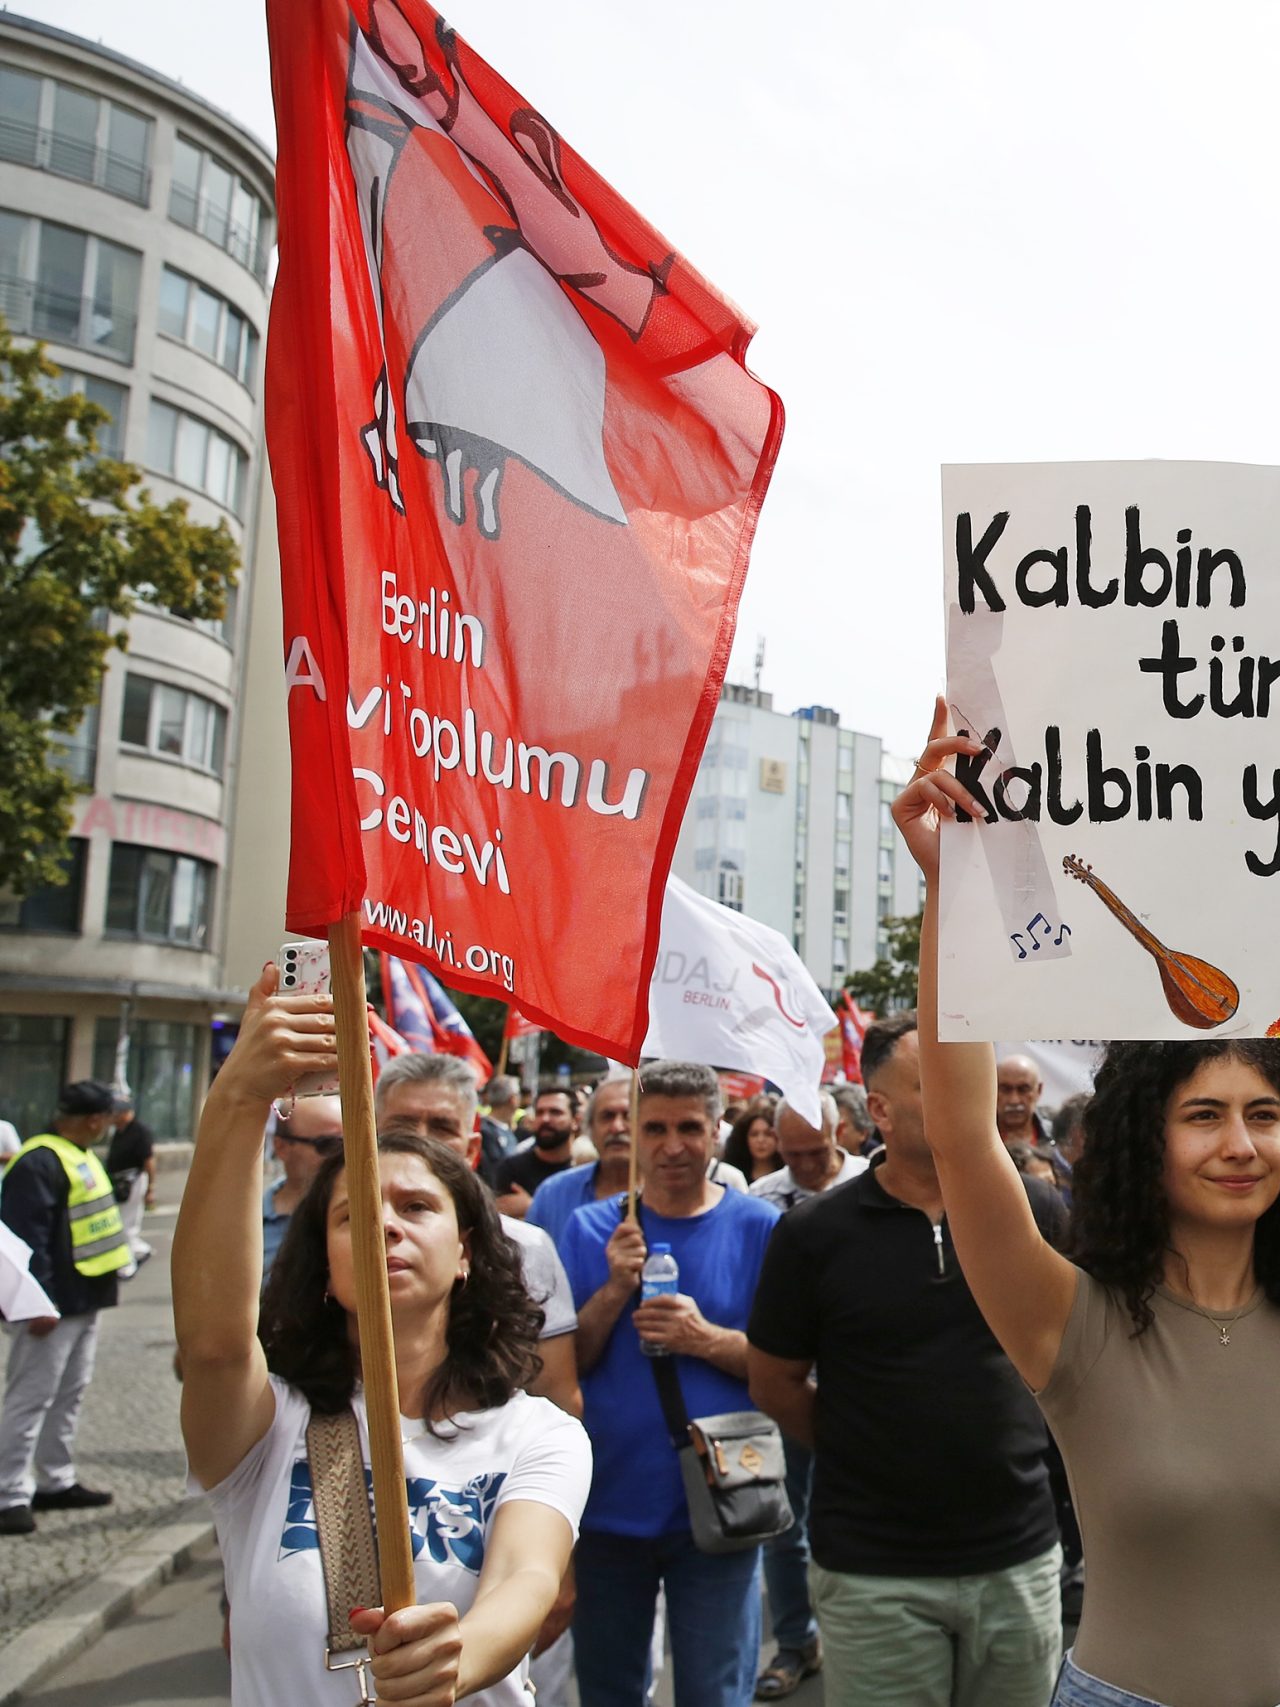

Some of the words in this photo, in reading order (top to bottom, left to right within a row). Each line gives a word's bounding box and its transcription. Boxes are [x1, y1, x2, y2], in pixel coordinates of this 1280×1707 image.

[956, 504, 1246, 614] Kalbin
[381, 570, 483, 668] Berlin
[954, 725, 1204, 827] Kalbin
[683, 990, 731, 1010] BERLIN
